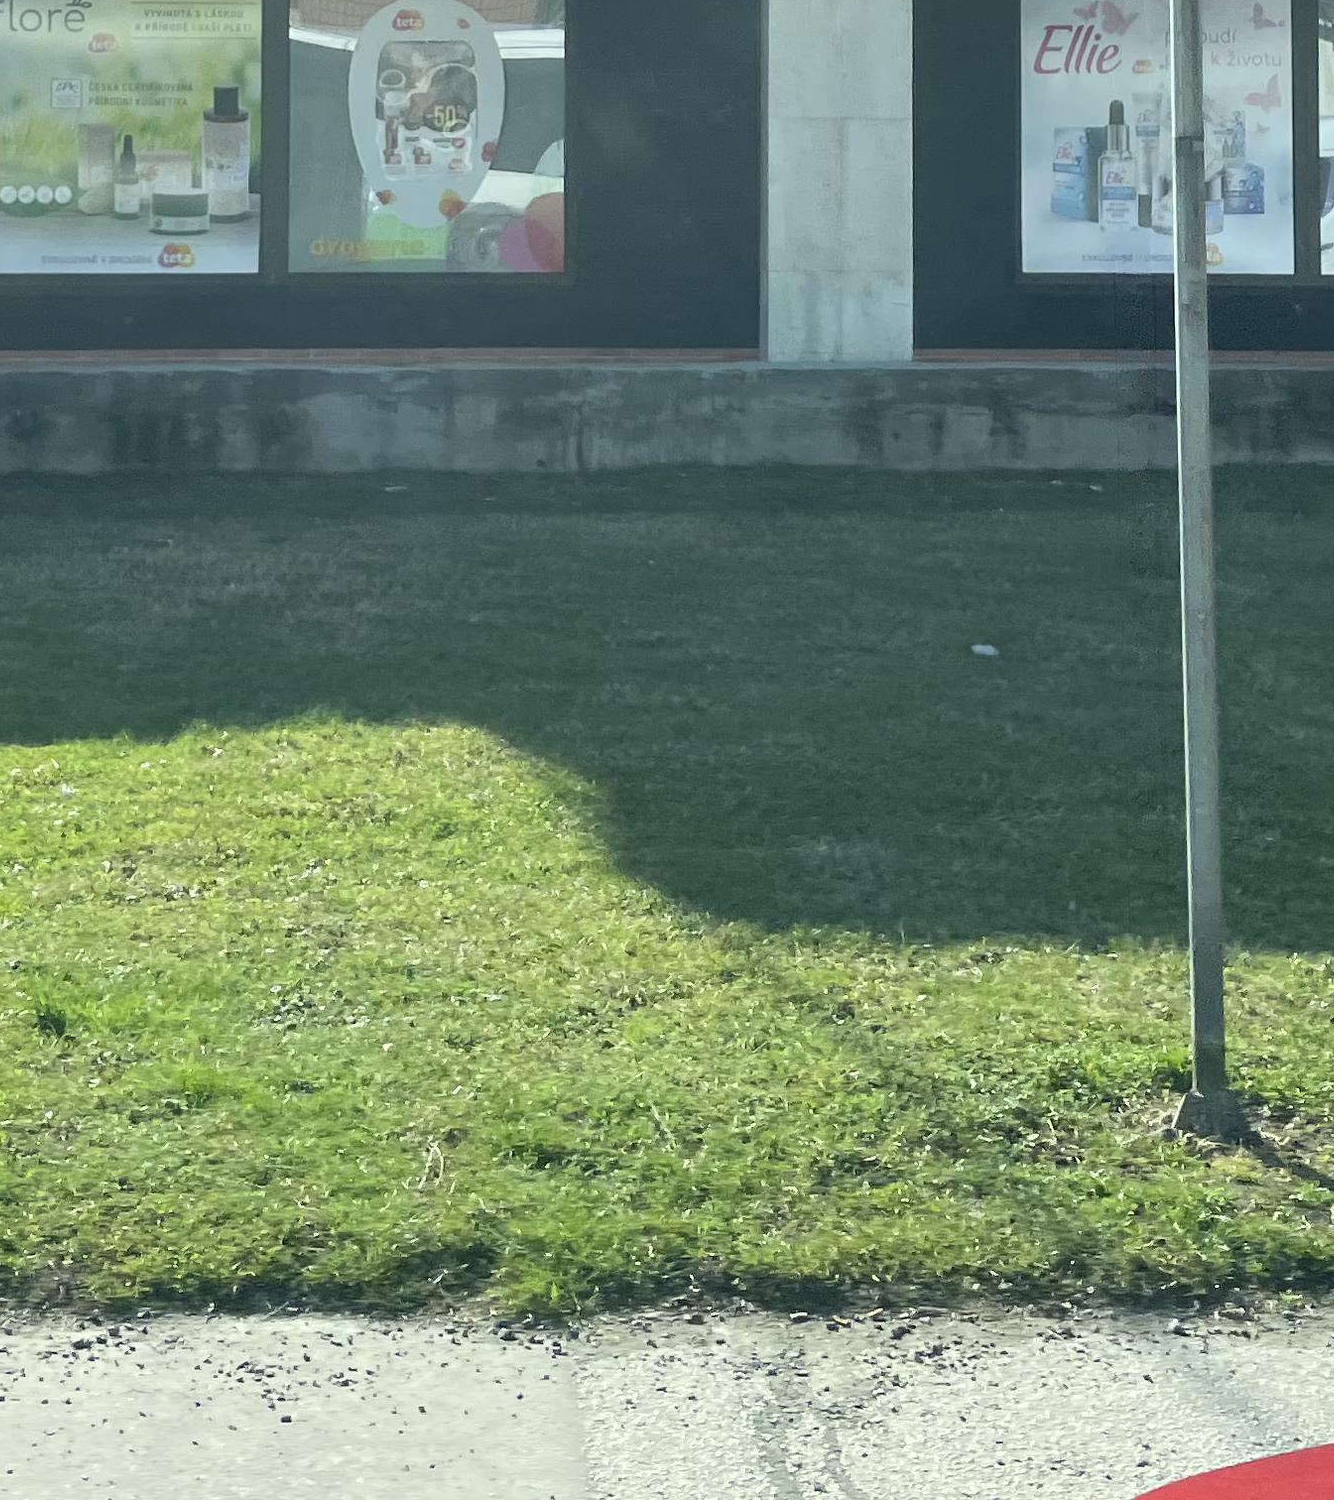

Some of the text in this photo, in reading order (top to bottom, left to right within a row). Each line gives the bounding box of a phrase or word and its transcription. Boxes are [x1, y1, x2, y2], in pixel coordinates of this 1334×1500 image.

[397, 17, 421, 28] teta
[1033, 24, 1122, 74] Ellie
[1227, 48, 1282, 67] životu
